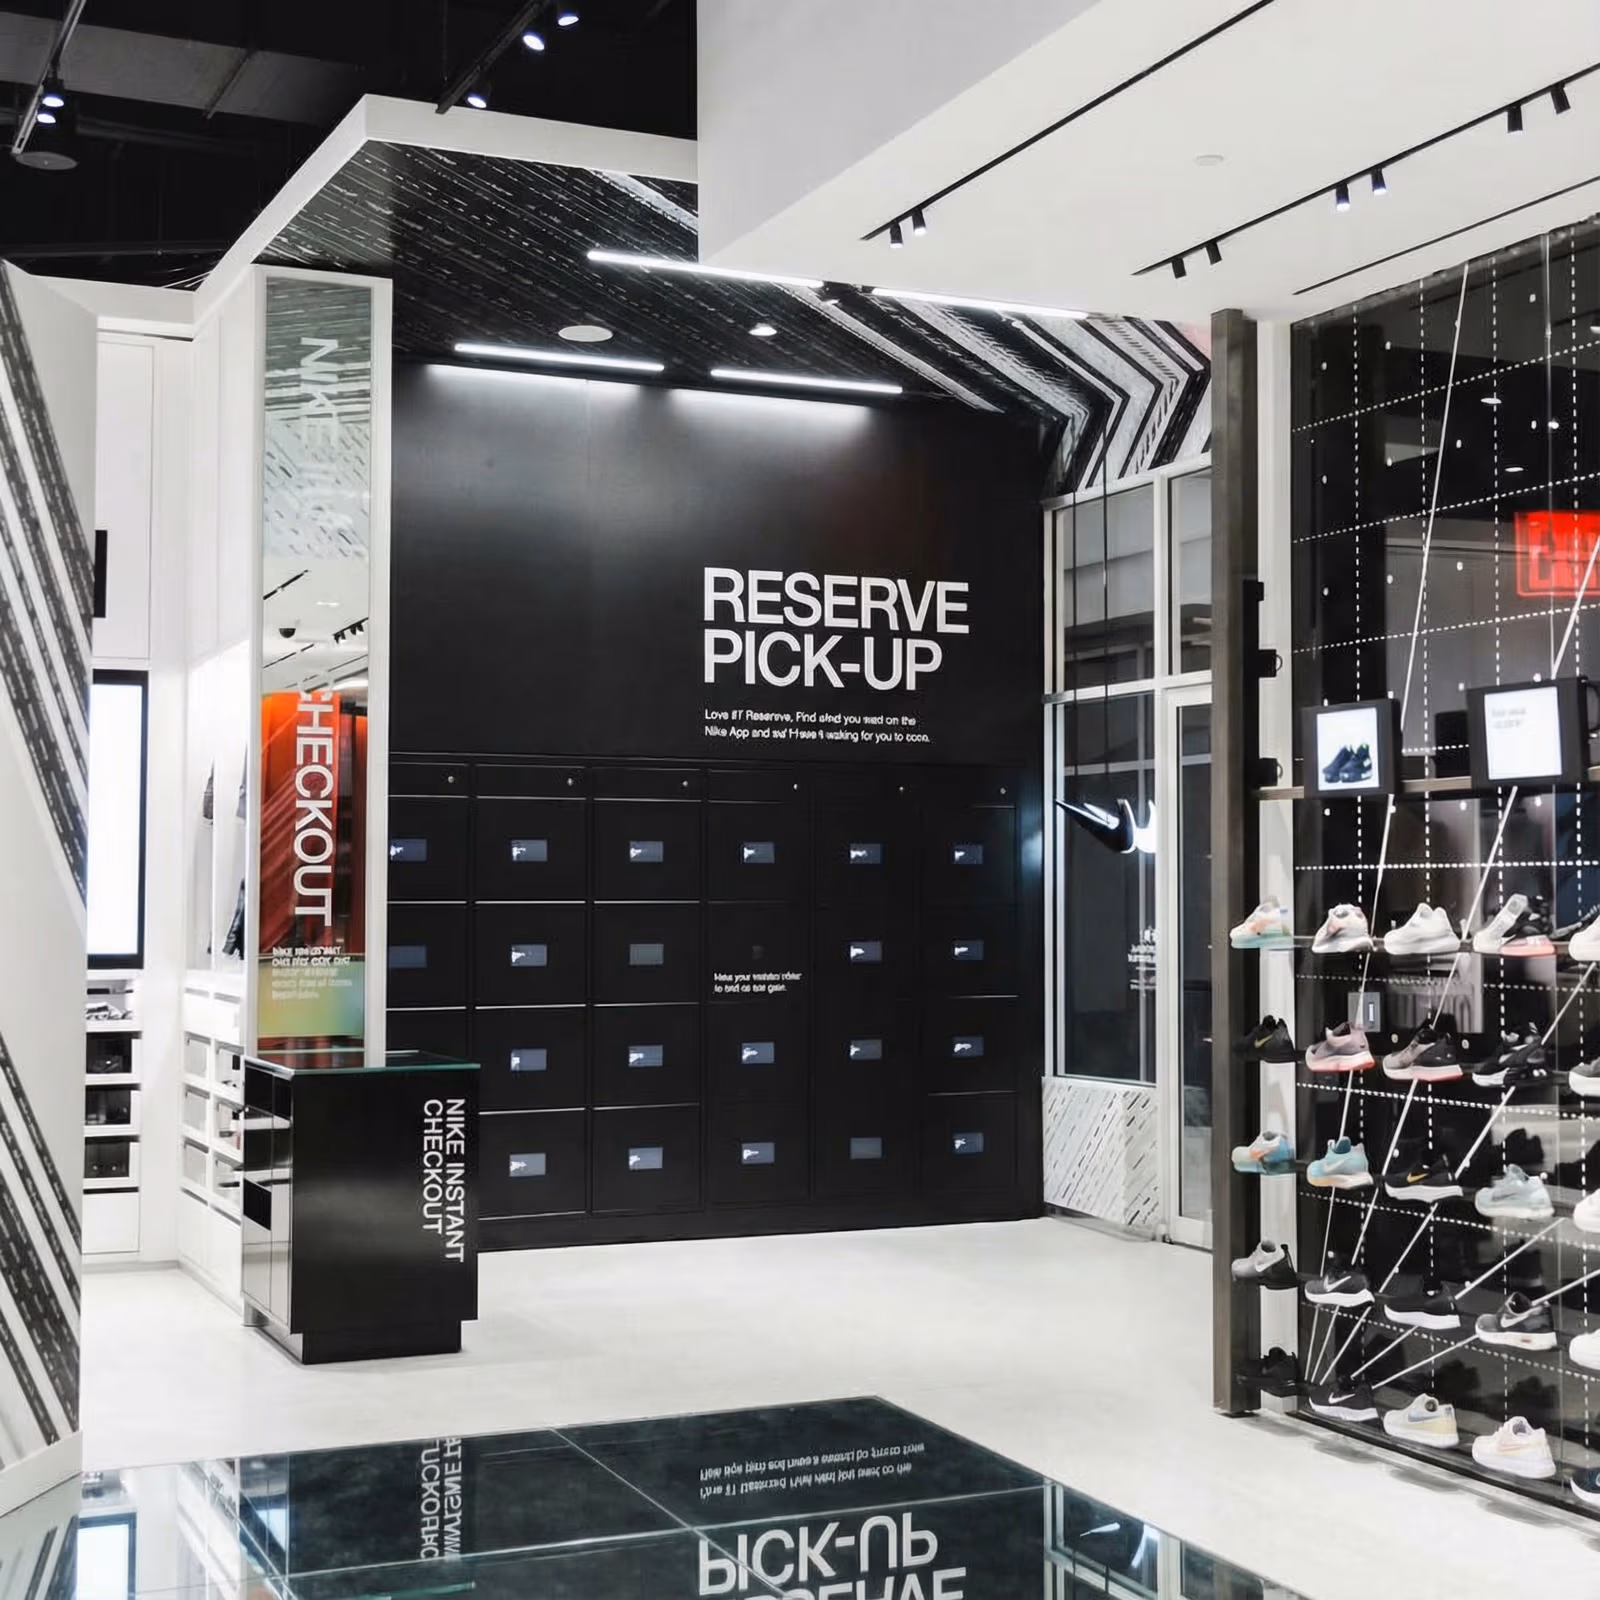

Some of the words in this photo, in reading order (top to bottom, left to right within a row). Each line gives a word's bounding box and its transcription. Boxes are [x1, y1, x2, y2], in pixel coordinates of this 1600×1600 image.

[704, 567, 969, 633] RESERVE
[704, 629, 942, 690] PICK-UP
[705, 709, 728, 720] Love
[843, 715, 861, 726] you
[886, 717, 899, 725] on
[729, 726, 750, 739] App
[861, 730, 874, 740] for
[875, 733, 892, 744] you
[446, 1099, 465, 1154] NIKE
[422, 1099, 443, 1235] CHECKOUT
[445, 1163, 465, 1262] INSTANT
